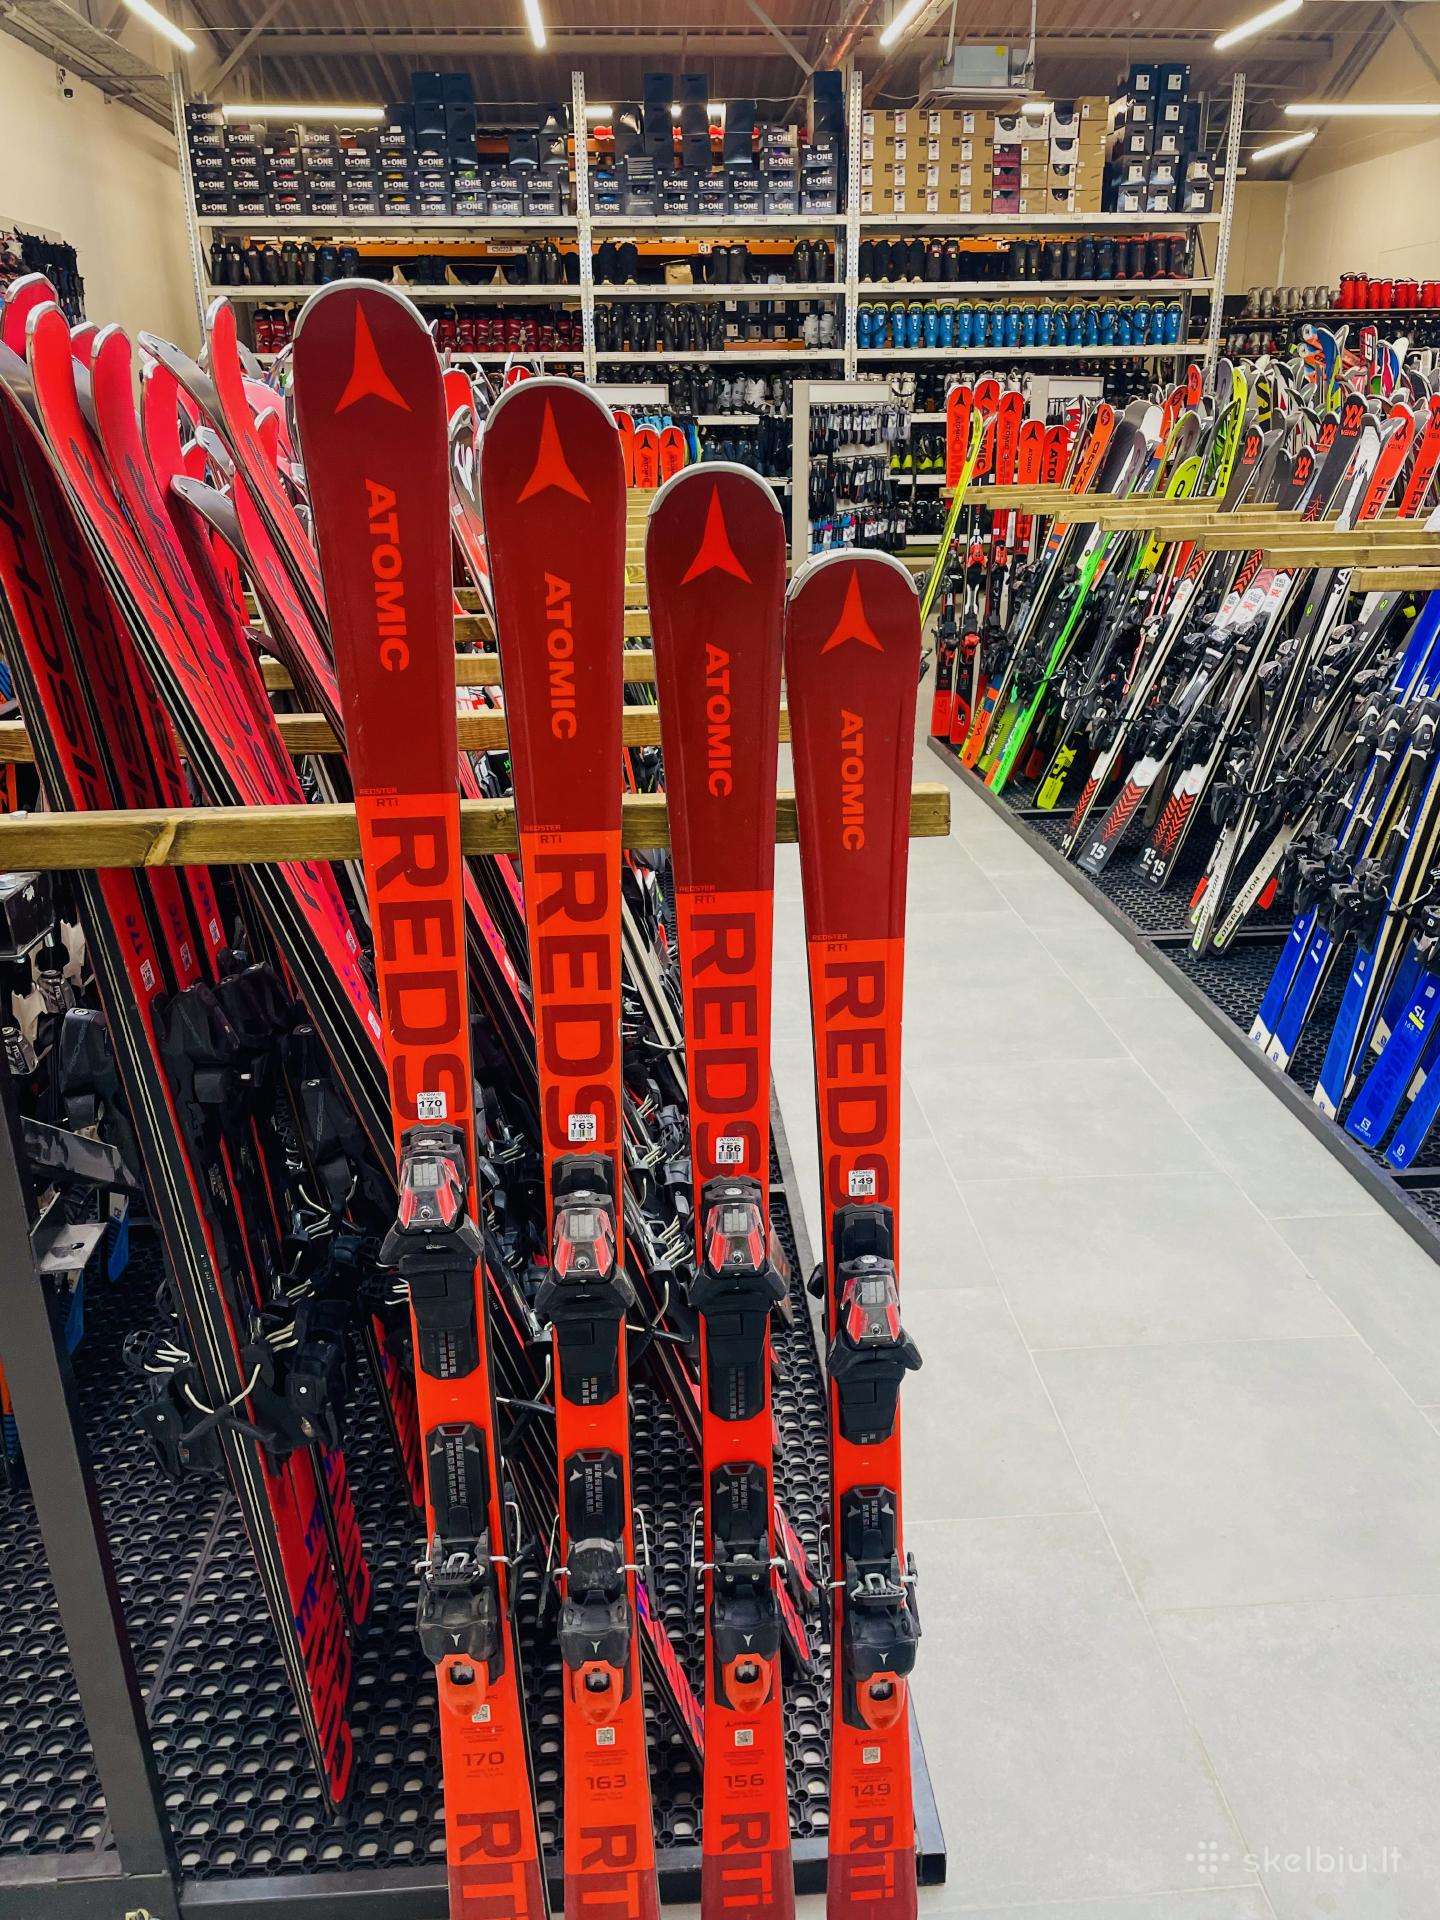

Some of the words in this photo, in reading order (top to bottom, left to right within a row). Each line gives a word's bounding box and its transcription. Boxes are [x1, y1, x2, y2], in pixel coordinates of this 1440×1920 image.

[1048, 448, 1058, 483] ATO
[364, 478, 410, 672] ATOMIC
[545, 572, 577, 740] ATOMIC
[704, 642, 733, 798] ATOMIC
[841, 708, 865, 850] ATOMIC
[524, 824, 560, 832] REDSTER
[1090, 842, 1108, 860] 15
[1152, 859, 1166, 876] 15
[371, 816, 468, 1121] REDS
[534, 853, 617, 1150] REDS
[1414, 1005, 1426, 1024] SL
[690, 912, 761, 1179] REDS
[824, 960, 890, 1206] REDS
[418, 1100, 442, 1108] 170
[572, 1122, 594, 1130] 163
[719, 1144, 741, 1152] 156
[464, 1751, 504, 1767] 170
[586, 1774, 627, 1790] 163
[724, 1773, 765, 1788] 156
[852, 1782, 891, 1798] 149
[580, 1824, 640, 1918] RT
